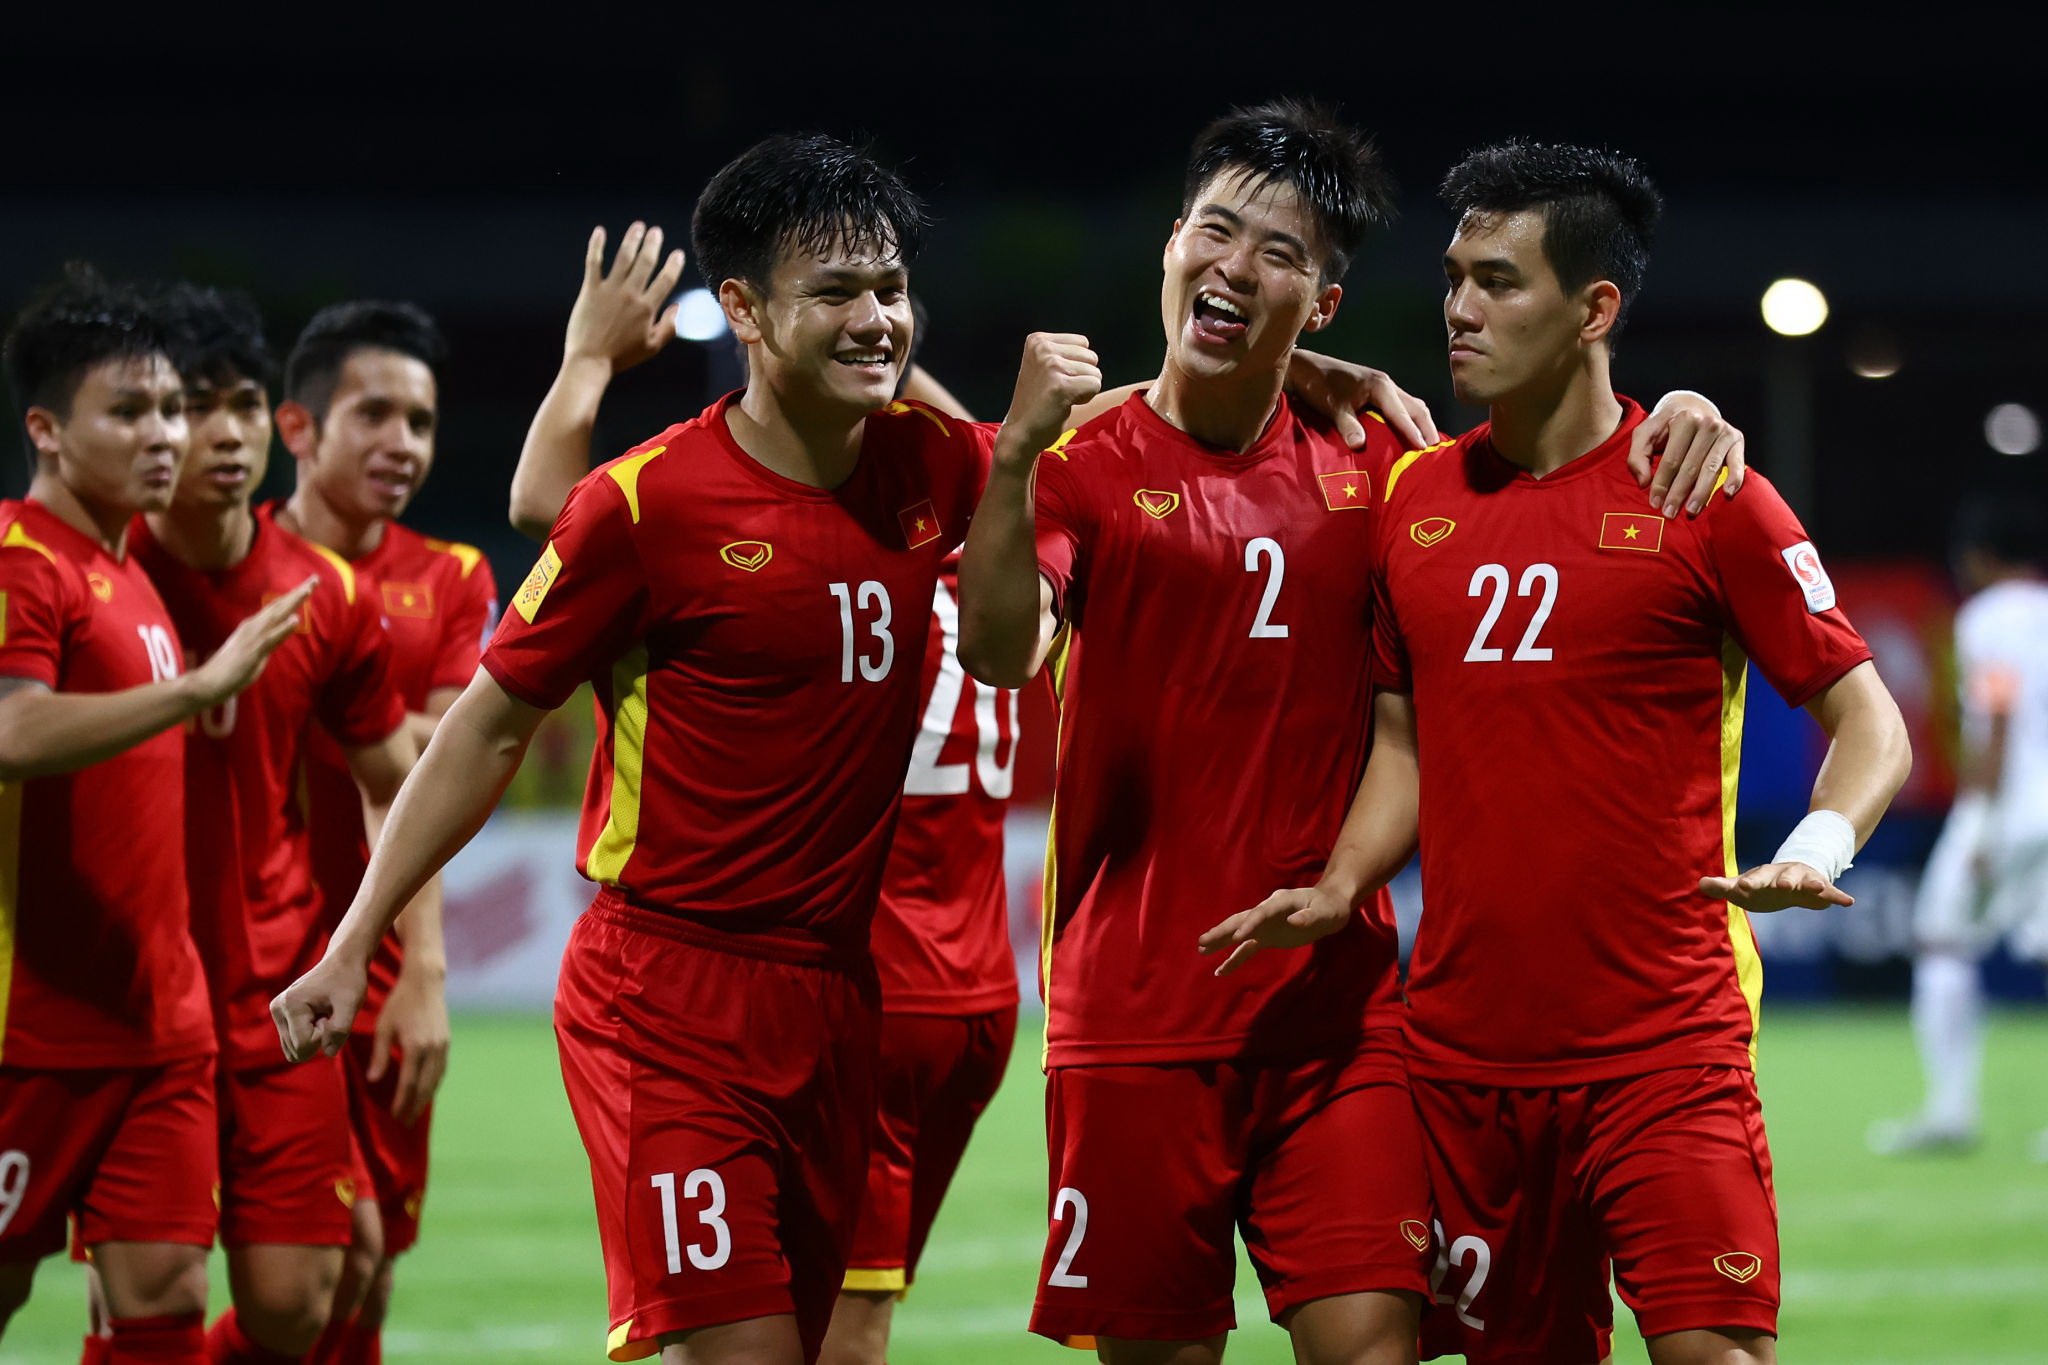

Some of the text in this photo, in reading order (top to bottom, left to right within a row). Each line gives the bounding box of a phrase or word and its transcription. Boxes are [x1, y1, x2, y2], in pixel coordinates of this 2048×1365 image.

[828, 580, 895, 683] 13
[1245, 537, 1289, 639] 2
[1463, 563, 1559, 663] 22
[651, 1168, 732, 1275] 13
[1047, 1187, 1089, 1289] 2
